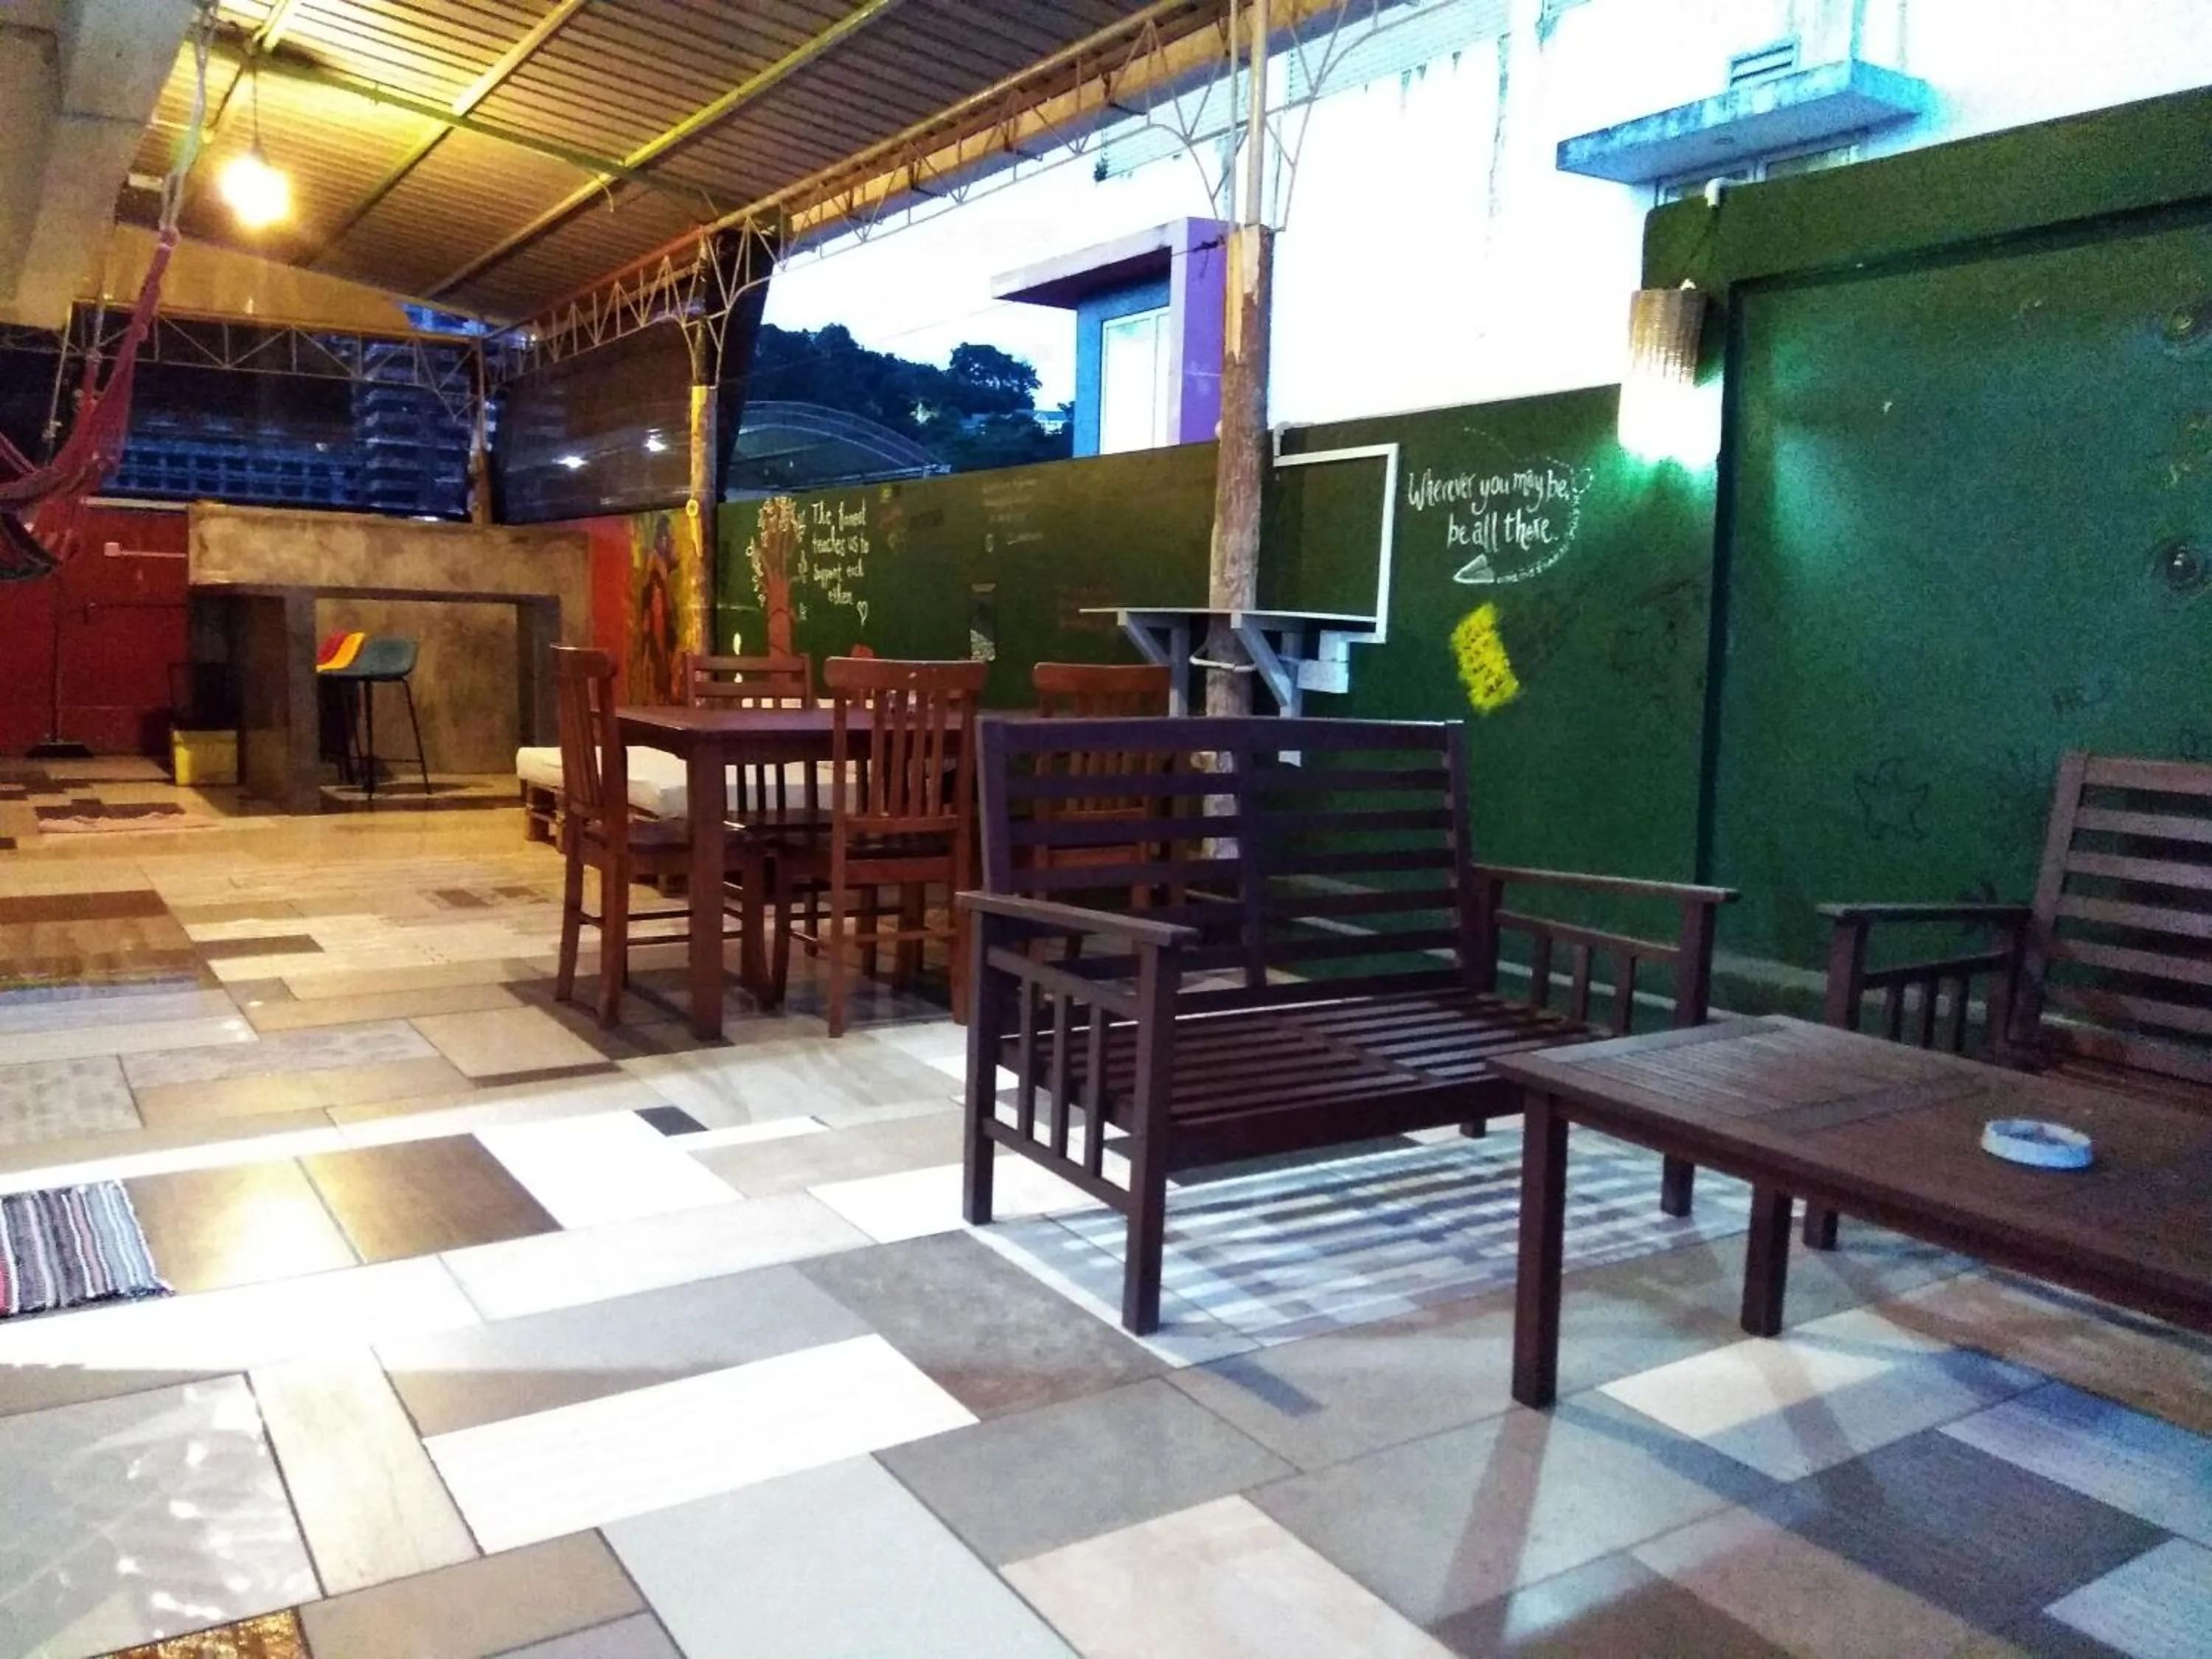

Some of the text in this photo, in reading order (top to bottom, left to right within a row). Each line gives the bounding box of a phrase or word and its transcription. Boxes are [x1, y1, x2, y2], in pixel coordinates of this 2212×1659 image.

[1408, 468, 1476, 511] Wherever
[1471, 476, 1509, 515] you
[1513, 469, 1543, 514] may
[811, 501, 832, 525] The
[1447, 513, 1471, 549] be
[1472, 511, 1498, 553] all
